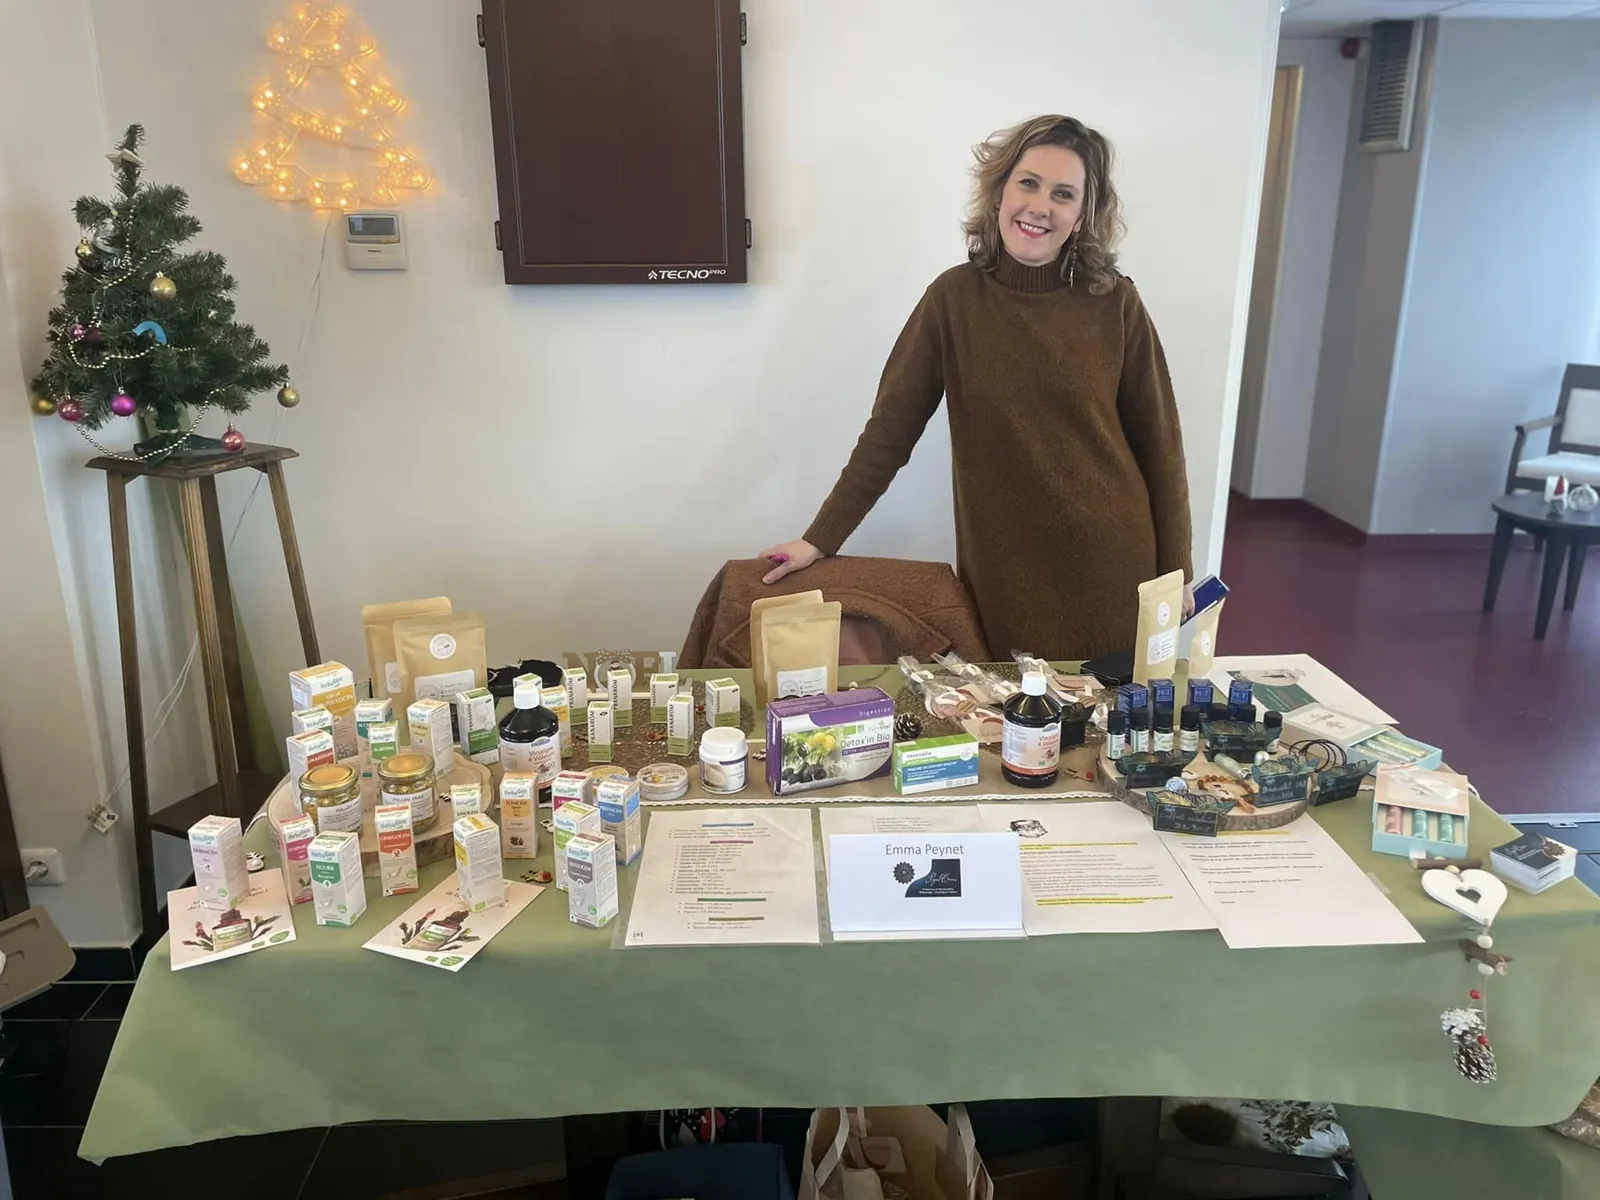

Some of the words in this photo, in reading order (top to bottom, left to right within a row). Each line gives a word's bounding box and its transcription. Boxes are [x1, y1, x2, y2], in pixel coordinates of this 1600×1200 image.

[859, 706, 891, 716] Digestion
[876, 732, 890, 742] Bio
[886, 844, 921, 856] Emma
[925, 844, 964, 857] Peynet
